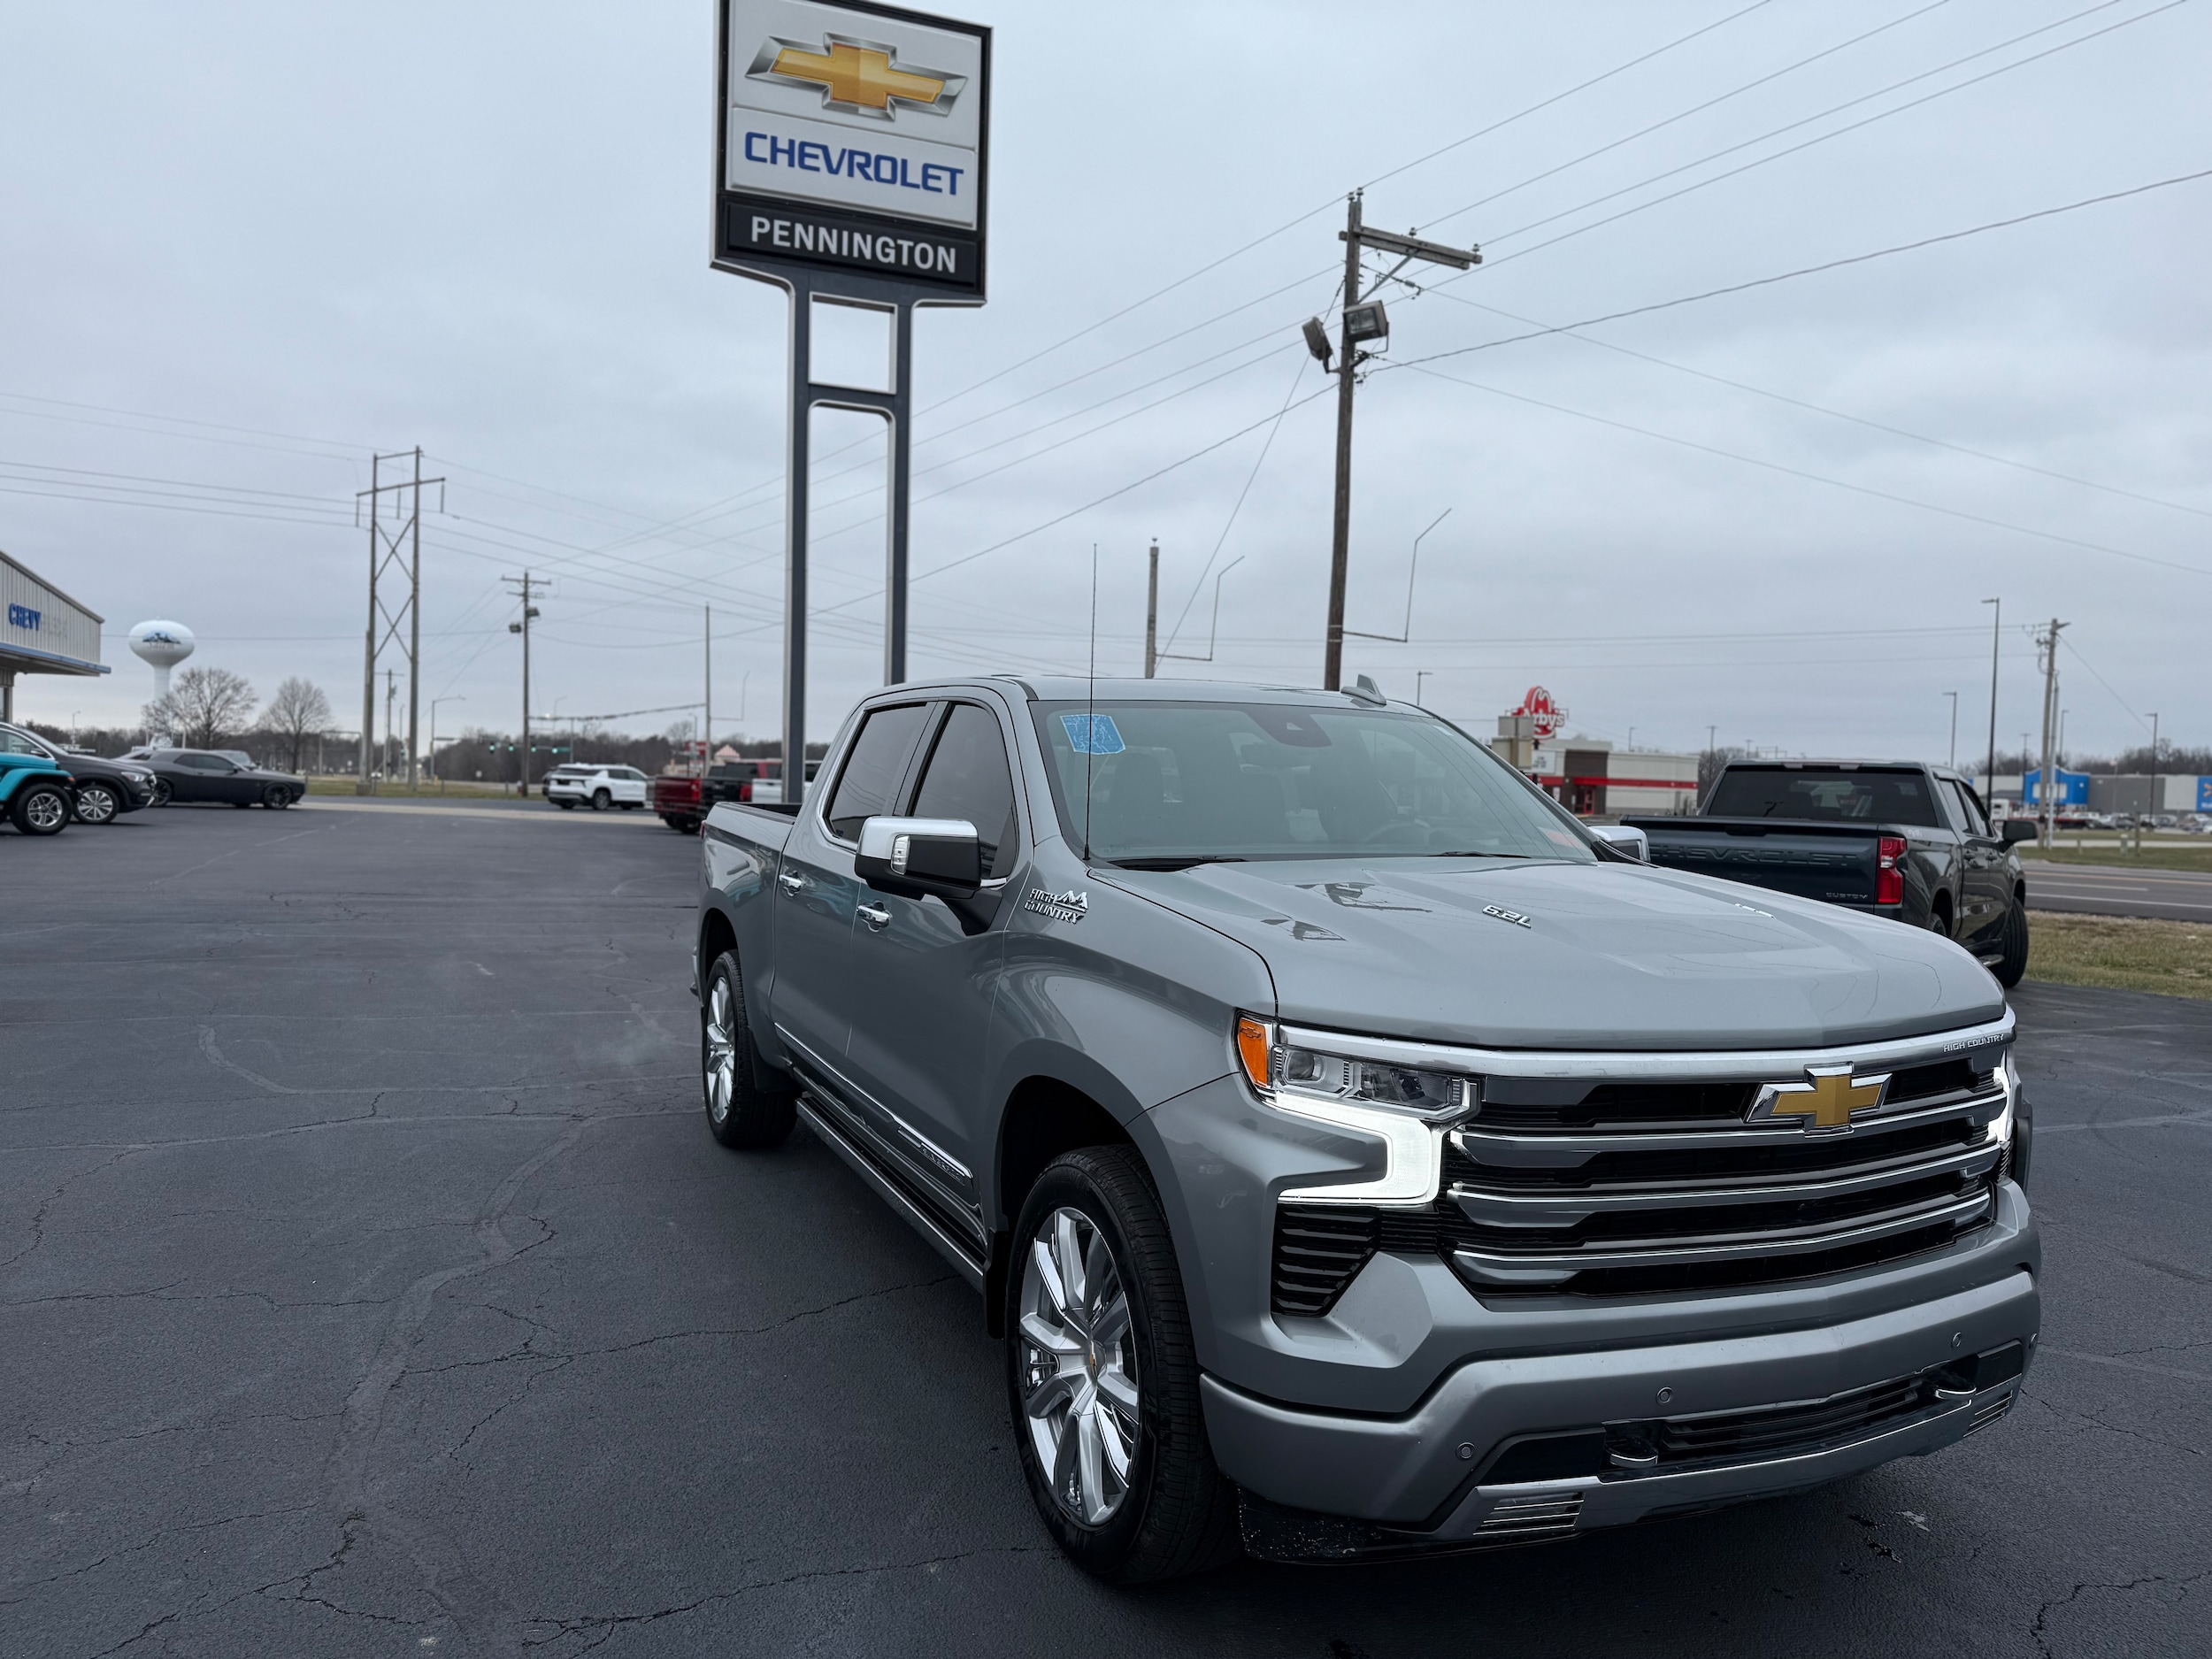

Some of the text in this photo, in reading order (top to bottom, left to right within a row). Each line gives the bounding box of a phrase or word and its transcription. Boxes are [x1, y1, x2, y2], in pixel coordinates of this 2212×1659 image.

[745, 131, 964, 196] CHEVROLET
[751, 216, 956, 273] PENNINGTON
[9, 603, 42, 631] CHEVY
[1029, 888, 1059, 904] HIGH
[1024, 899, 1081, 925] COUNTRY
[1482, 904, 1532, 929] 6.2L
[1943, 1033, 2004, 1053] HIGH COUNTRY
